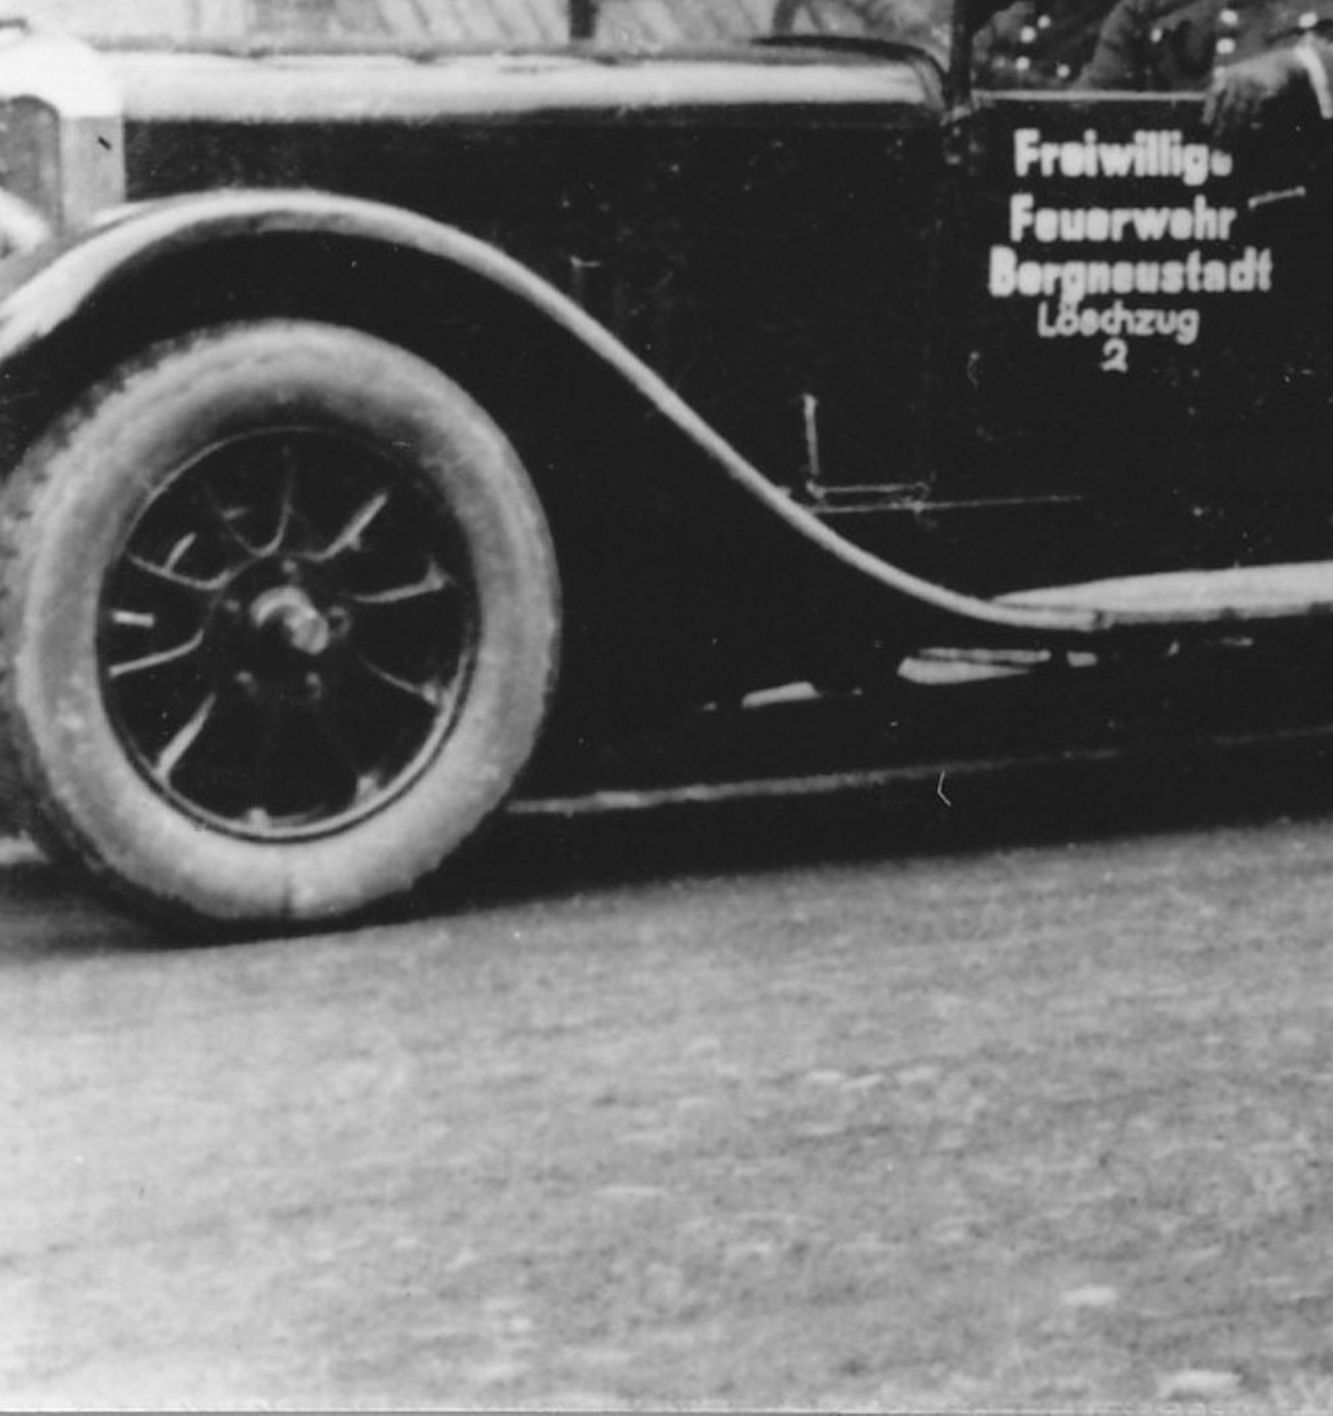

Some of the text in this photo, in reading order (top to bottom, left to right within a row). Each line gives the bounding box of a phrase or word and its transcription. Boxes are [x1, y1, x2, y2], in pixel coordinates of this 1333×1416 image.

[1013, 128, 1233, 186] Freiwillige
[1009, 193, 1237, 243] Feuerwehr
[988, 244, 1273, 303] Bergneustadt
[1100, 337, 1128, 373] 2
